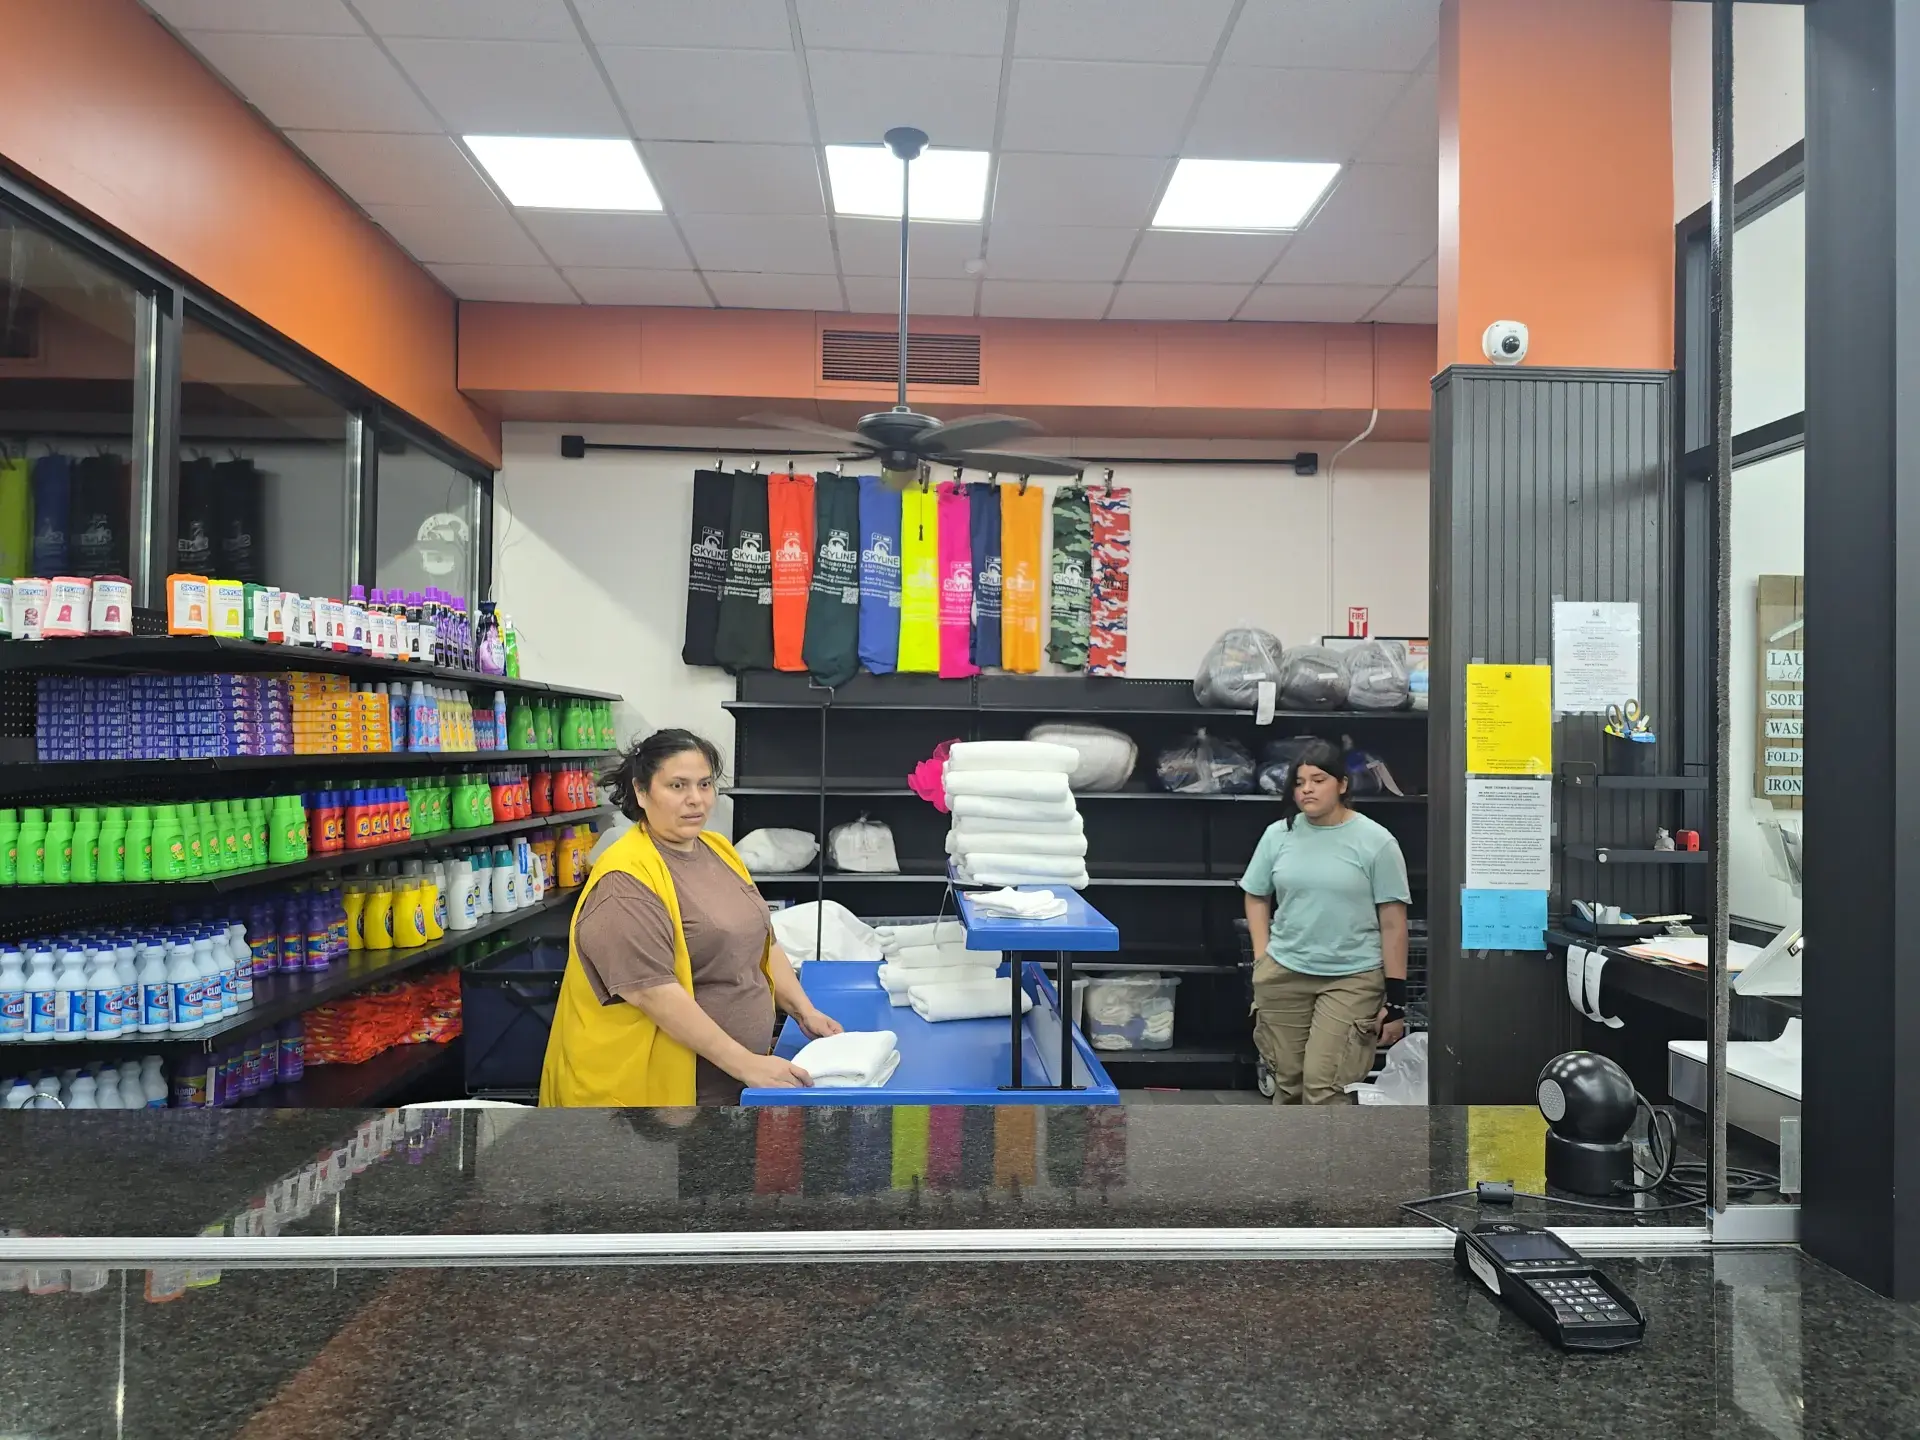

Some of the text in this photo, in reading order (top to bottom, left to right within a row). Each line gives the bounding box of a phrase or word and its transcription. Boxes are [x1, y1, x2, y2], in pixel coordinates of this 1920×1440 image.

[693, 545, 728, 559] SKYLINE
[732, 549, 770, 562] SKYLINE
[821, 545, 857, 561] SKYLINE
[863, 552, 900, 567] SKYLINE
[1352, 612, 1365, 620] FIRE
[1767, 751, 1802, 762] FOLD:
